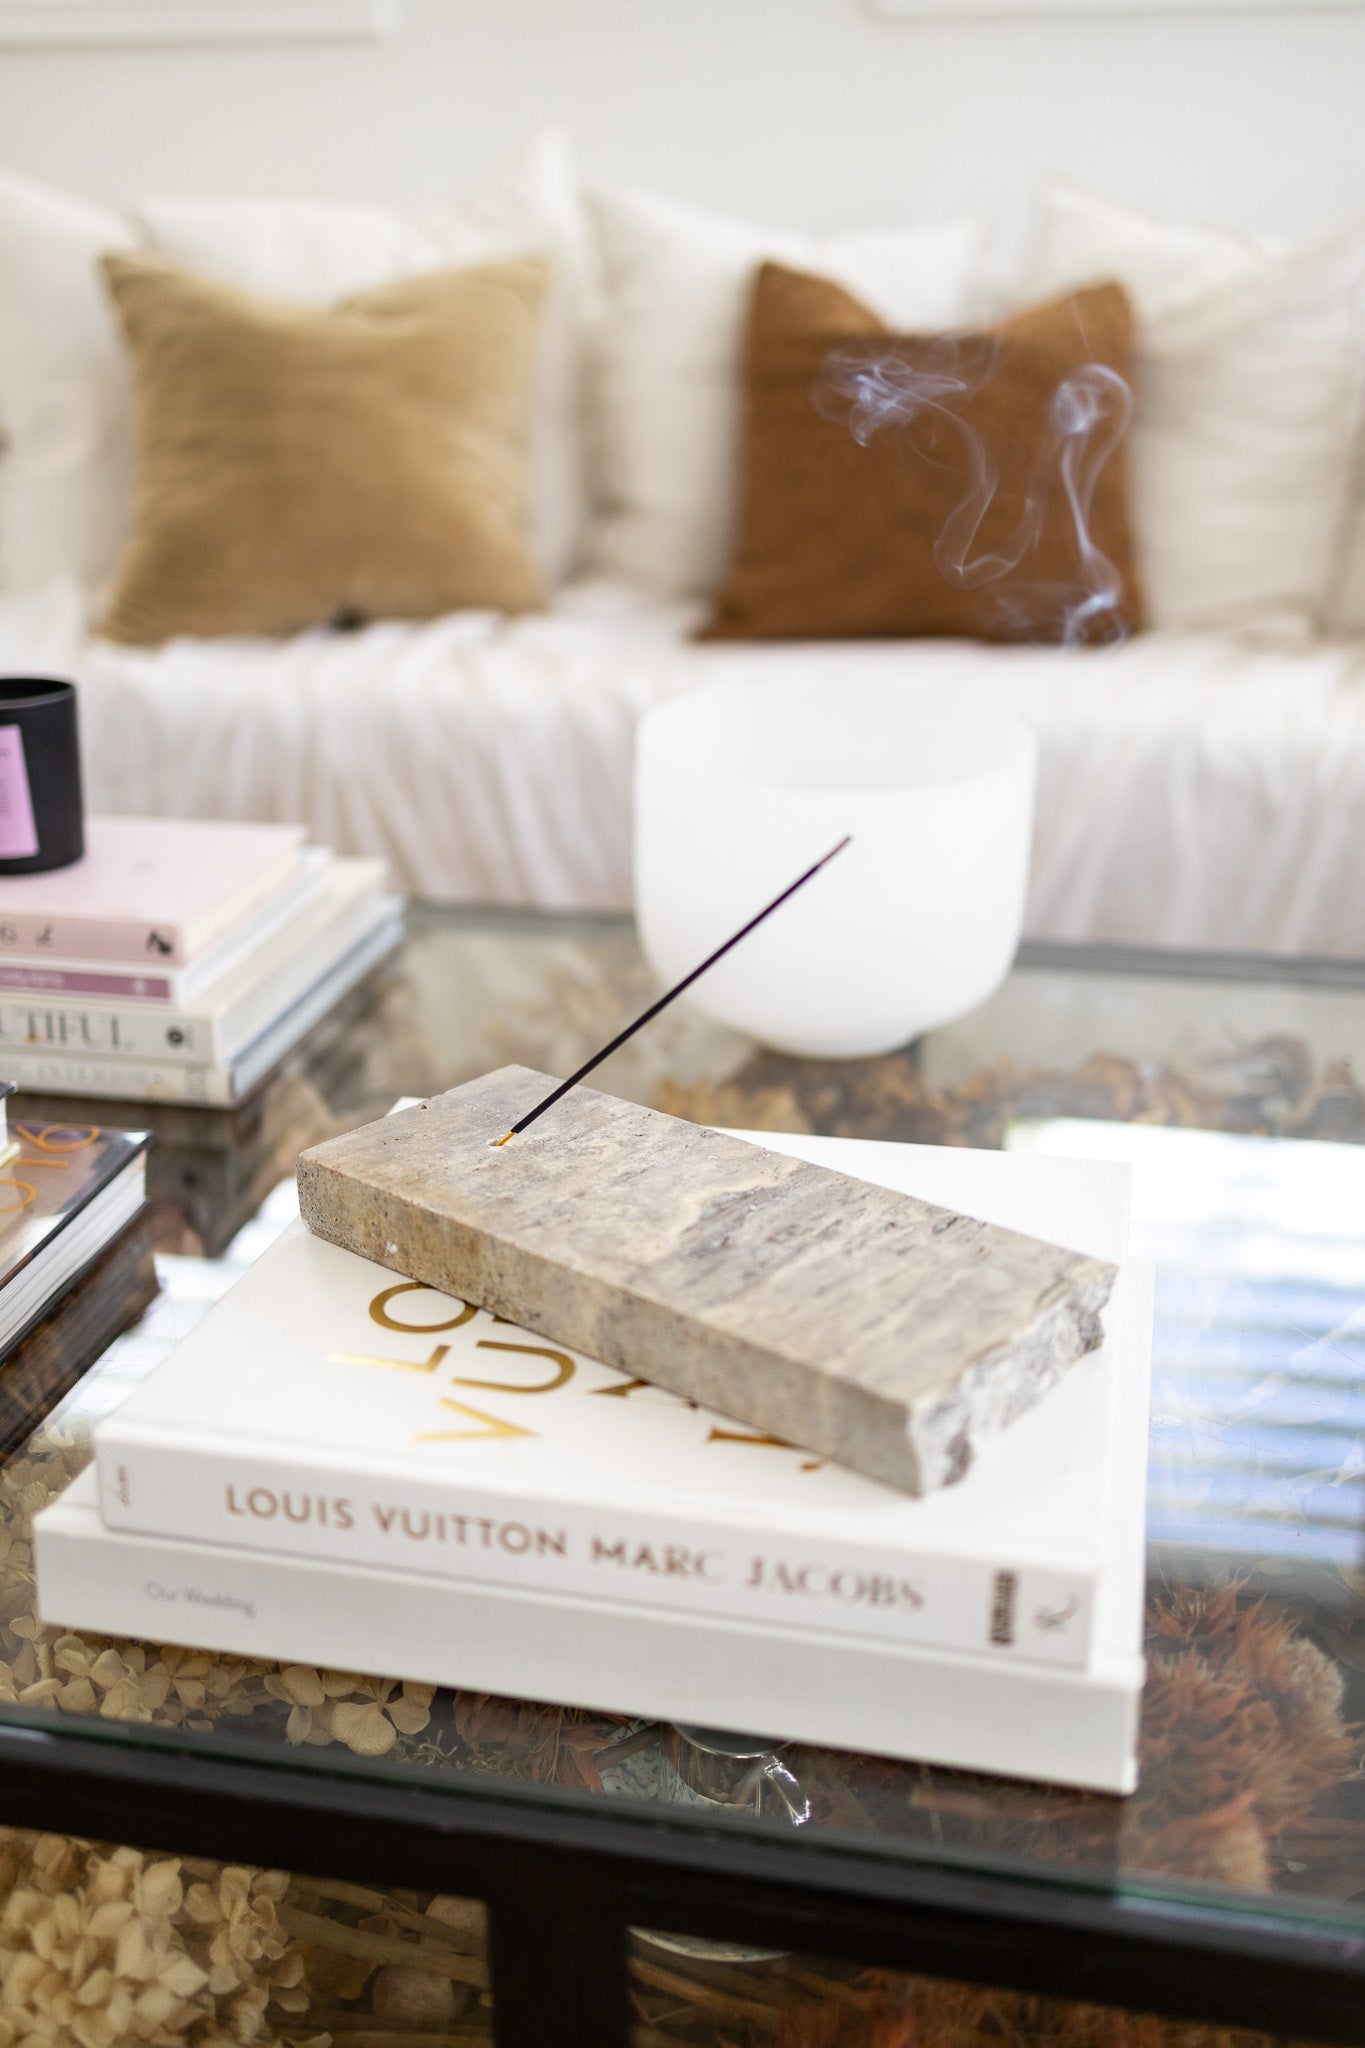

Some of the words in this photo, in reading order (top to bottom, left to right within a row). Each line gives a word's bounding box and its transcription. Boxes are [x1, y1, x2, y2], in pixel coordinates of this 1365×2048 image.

[412, 1320, 579, 1443] VU
[224, 1483, 354, 1531] LOUIS
[372, 1502, 567, 1559] VUITTON
[591, 1535, 724, 1582] MARC
[747, 1555, 925, 1613] JACOBS
